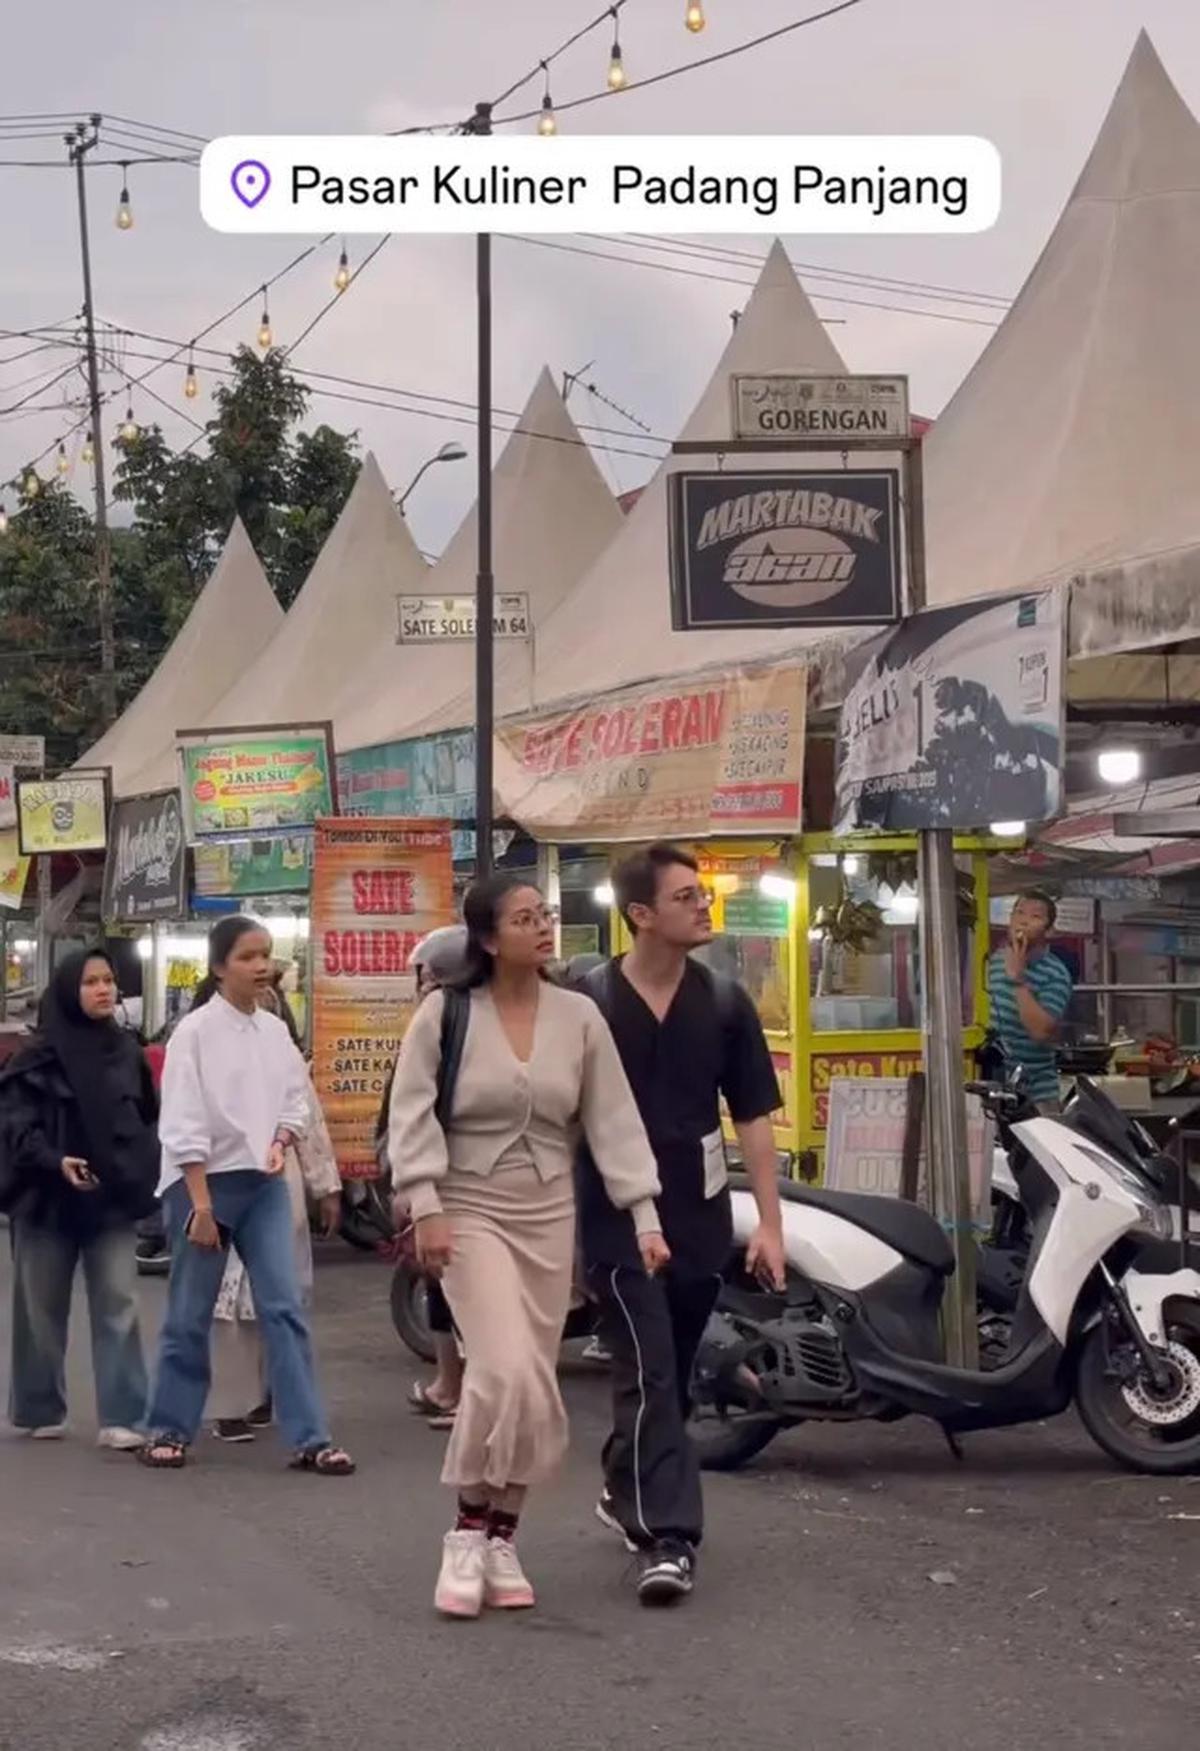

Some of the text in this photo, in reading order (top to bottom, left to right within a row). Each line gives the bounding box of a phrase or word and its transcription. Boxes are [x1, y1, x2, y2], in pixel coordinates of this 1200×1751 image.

[758, 408, 888, 432] GORENGAN
[696, 488, 884, 552] MARTABAK
[403, 618, 436, 636] SATE
[509, 617, 526, 634] 64
[352, 869, 415, 916] SATE
[337, 1037, 372, 1053] SATE
[334, 1057, 370, 1074] SATE
[332, 1079, 367, 1094] SATE
